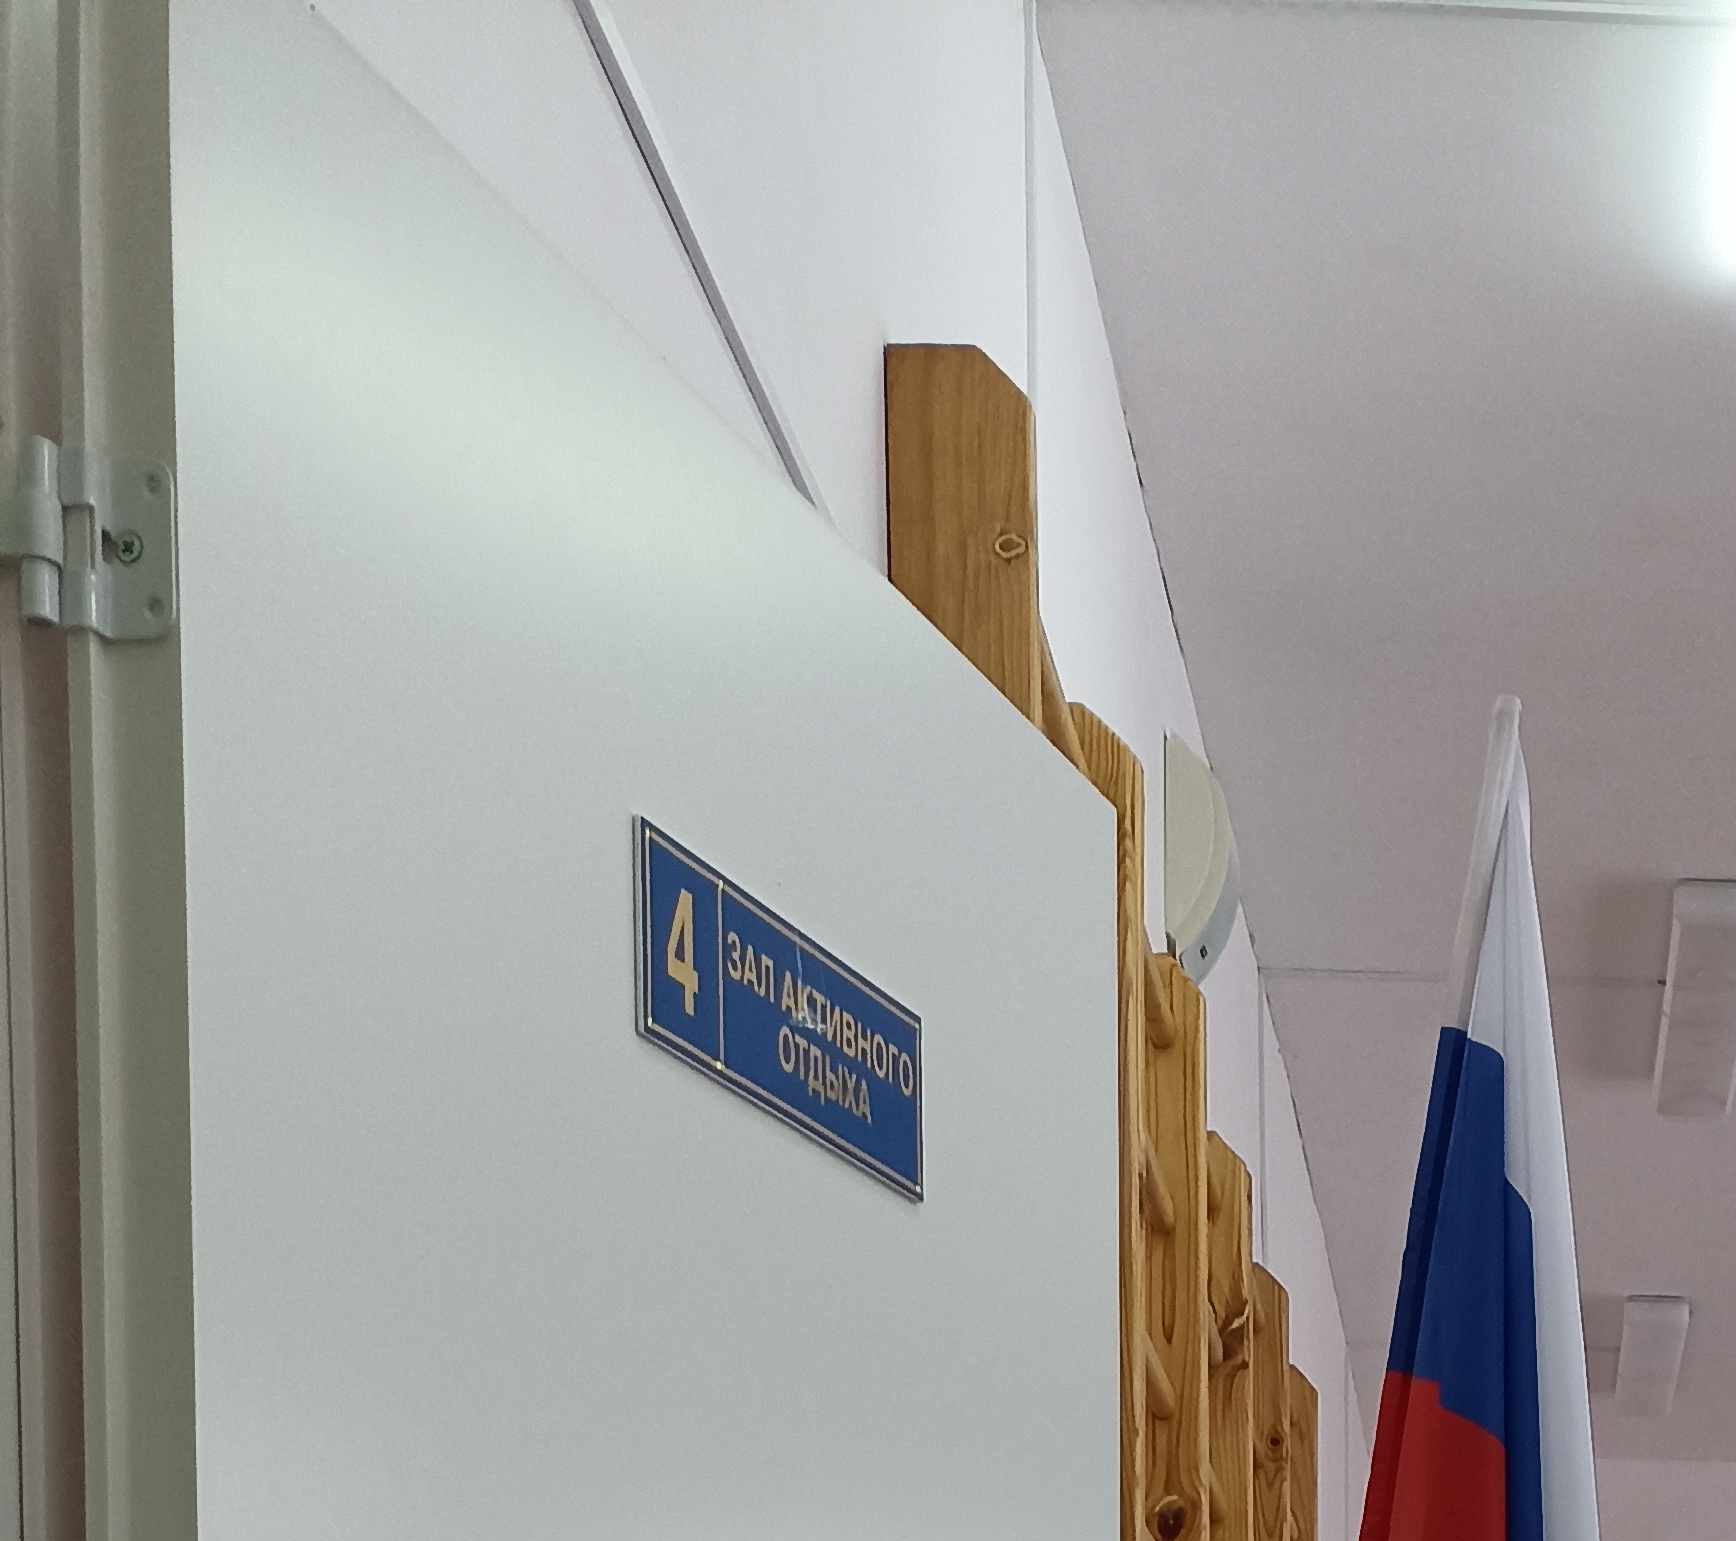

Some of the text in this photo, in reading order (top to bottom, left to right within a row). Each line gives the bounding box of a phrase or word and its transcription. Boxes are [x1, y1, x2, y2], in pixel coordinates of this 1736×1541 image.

[666, 888, 699, 1017] 4
[726, 931, 913, 1097] ЗАЛ АКТИВНОГО
[777, 1025, 872, 1125] ОТДЫХА
